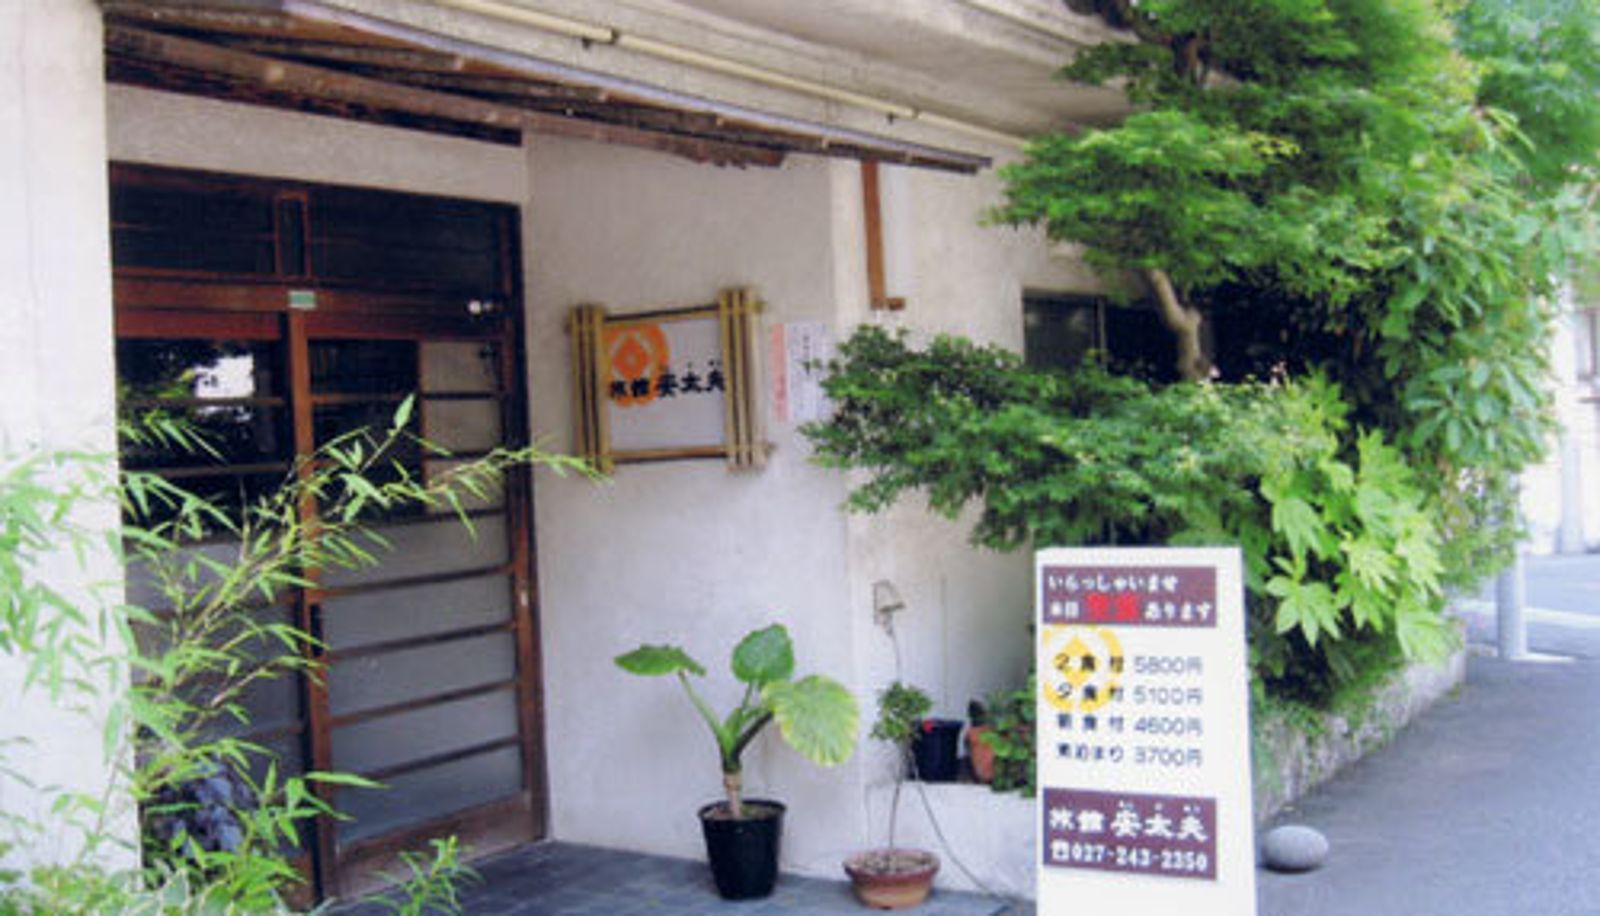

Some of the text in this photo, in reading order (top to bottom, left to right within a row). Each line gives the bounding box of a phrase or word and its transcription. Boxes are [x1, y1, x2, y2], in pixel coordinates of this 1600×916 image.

[1048, 574, 1179, 592] いらっしゃいませ
[1134, 656, 1203, 675] 5800円
[1134, 686, 1203, 706] 5100円
[1134, 746, 1203, 768] 3700円
